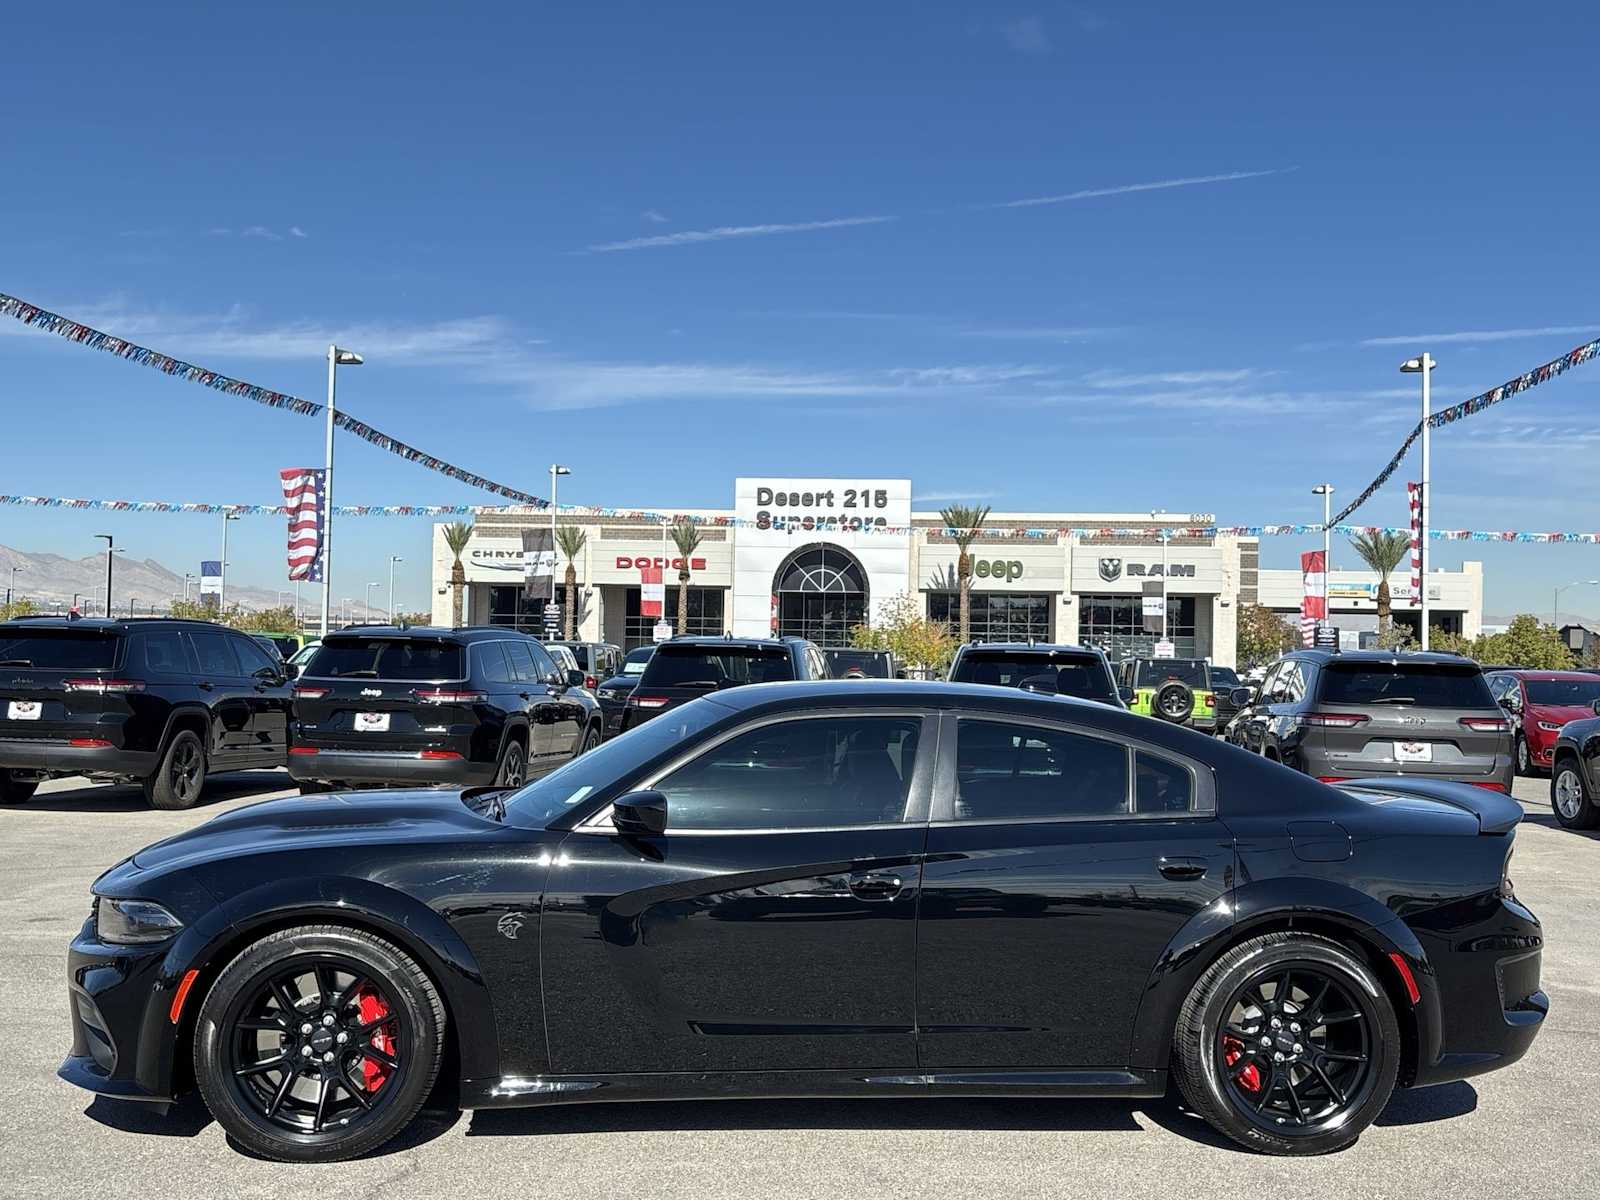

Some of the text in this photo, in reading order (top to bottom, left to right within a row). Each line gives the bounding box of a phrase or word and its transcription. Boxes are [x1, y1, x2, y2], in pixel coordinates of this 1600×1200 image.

[757, 487, 887, 508] Desert 215
[1126, 564, 1195, 577] RAM
[360, 688, 382, 697] Jeep
